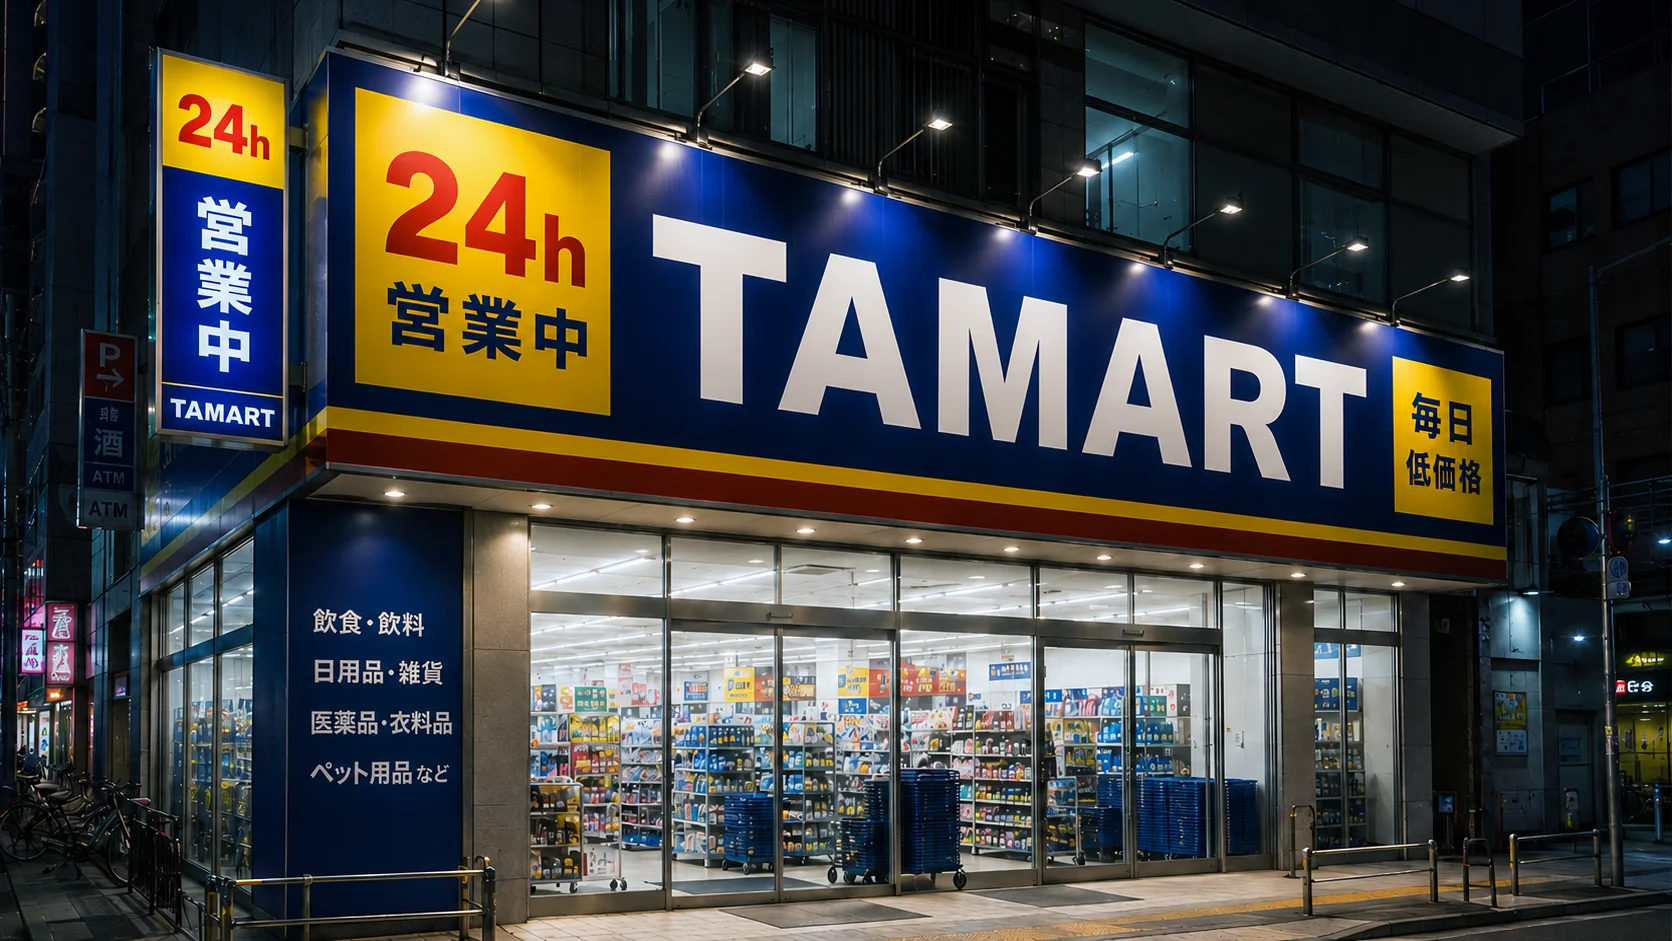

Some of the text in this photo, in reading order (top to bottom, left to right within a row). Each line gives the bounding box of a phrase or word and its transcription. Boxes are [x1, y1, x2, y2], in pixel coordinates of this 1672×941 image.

[178, 93, 270, 161] 24h
[385, 151, 587, 289] 24h
[196, 195, 253, 373] 営業中
[387, 280, 588, 371] 営業中
[99, 342, 121, 367] P
[652, 213, 1367, 490] TAMART
[170, 397, 276, 429] TAMART
[1411, 391, 1474, 446] 毎日
[94, 428, 123, 458] 酒
[92, 470, 125, 486] ATM
[1405, 448, 1482, 496] 低価格
[88, 500, 128, 520] ATM
[312, 608, 425, 638] 飲食・飲料
[313, 659, 444, 686] 日用品・雑貨
[310, 709, 453, 736] 医薬品・衣料品
